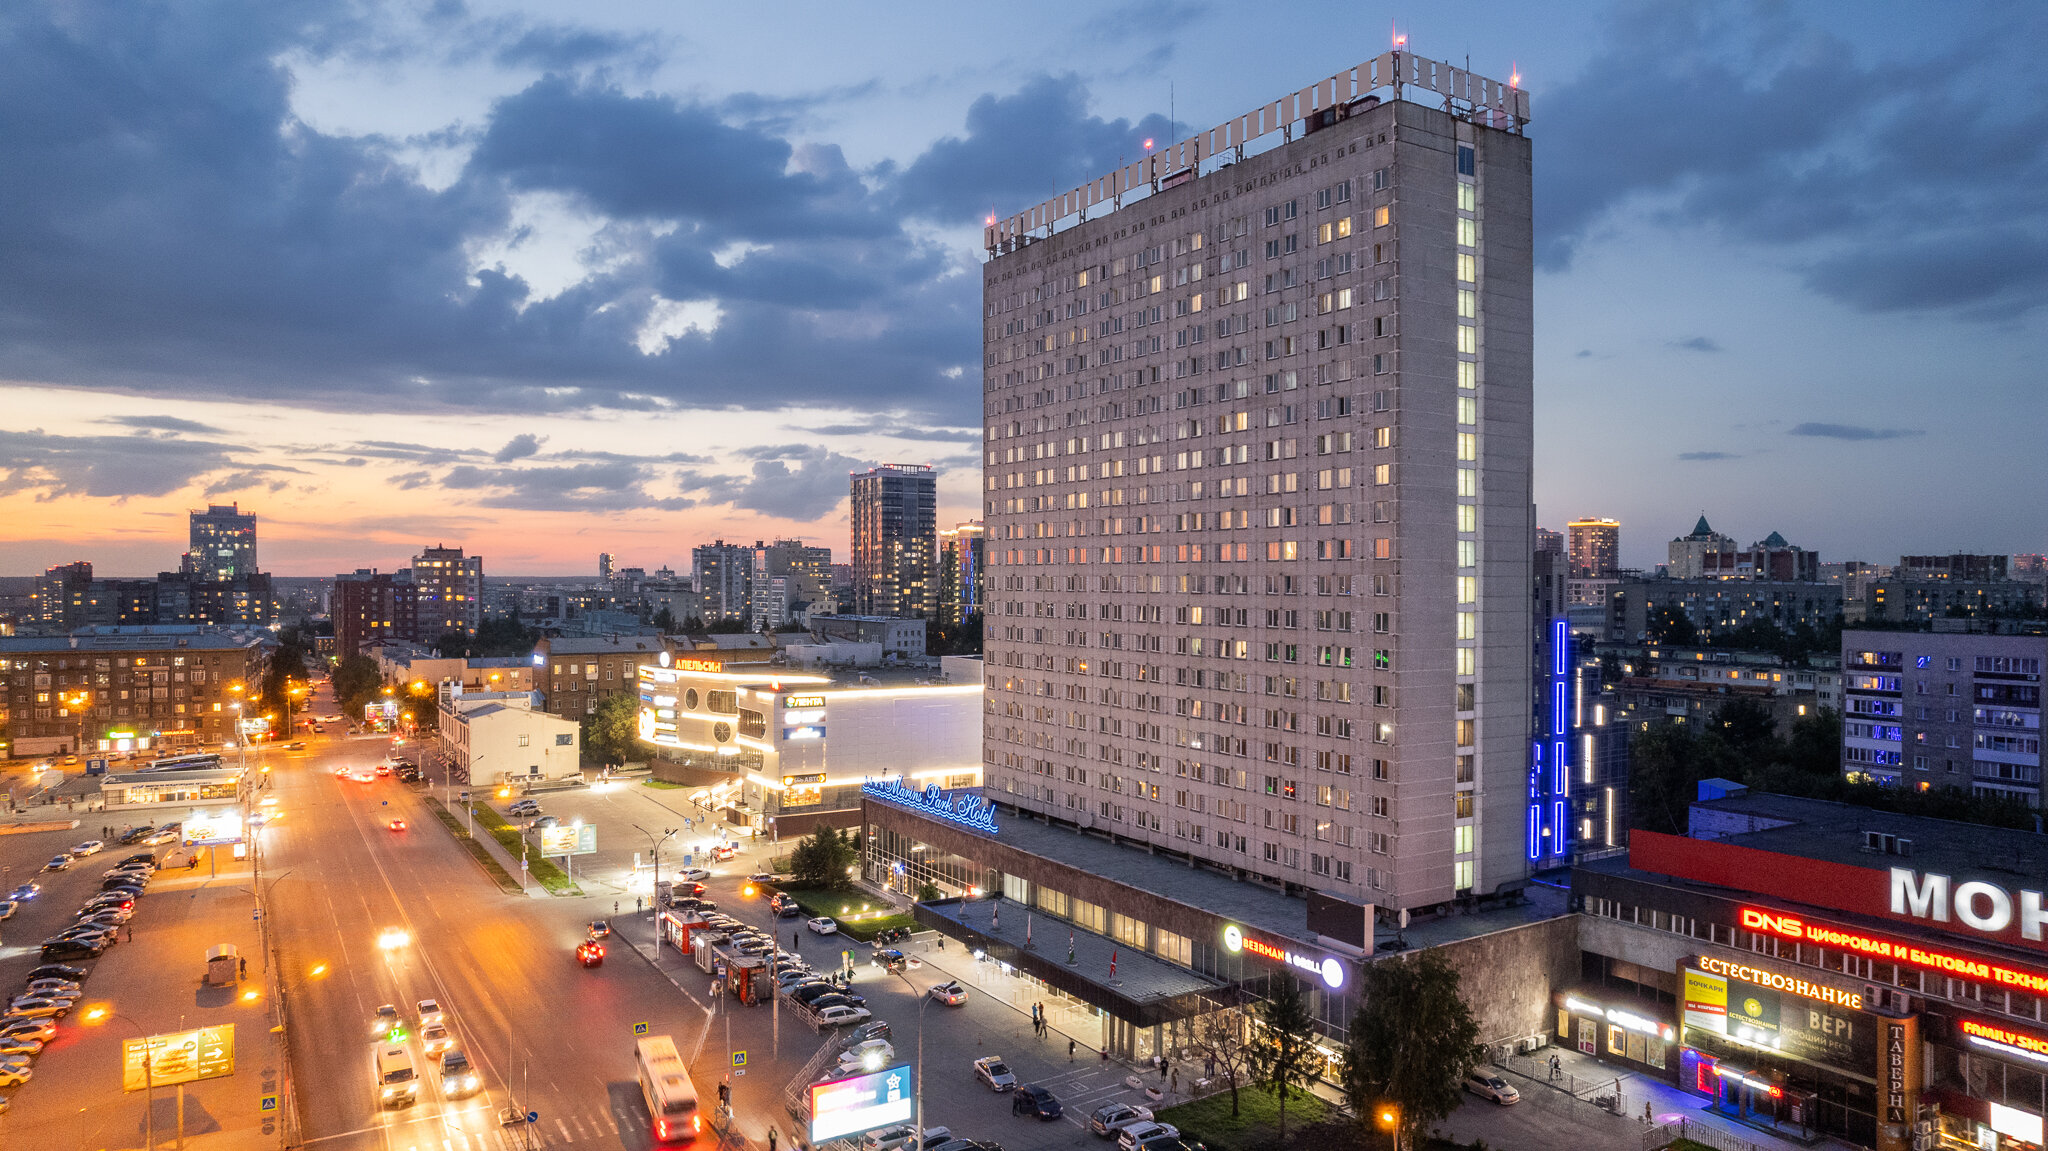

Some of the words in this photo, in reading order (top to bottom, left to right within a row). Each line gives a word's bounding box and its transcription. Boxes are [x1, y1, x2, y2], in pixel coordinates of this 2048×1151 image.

[675, 659, 722, 672] АПЕЛЬСИН
[794, 697, 824, 707] ЛЕНТА
[885, 775, 923, 803] Marins
[926, 783, 953, 812] Park
[957, 794, 997, 824] Hotel
[1242, 937, 1285, 961] BEERMAN
[1284, 951, 1293, 965] &
[1743, 909, 1803, 938] DNS
[1806, 926, 1891, 957] ЦИФРОВАЯ
[1894, 945, 1908, 960] И
[1910, 949, 1990, 979] БЫТОВАЯ
[1688, 979, 1724, 993] БОЧКАРИ
[1728, 1011, 1778, 1031] ЕСТЕСТВОЗНАНИЕ
[1781, 1026, 1827, 1047] ХОРОШИЙ
[1964, 1021, 2017, 1045] FAMILY
[1890, 1026, 1903, 1121] ТАВЕРНА
